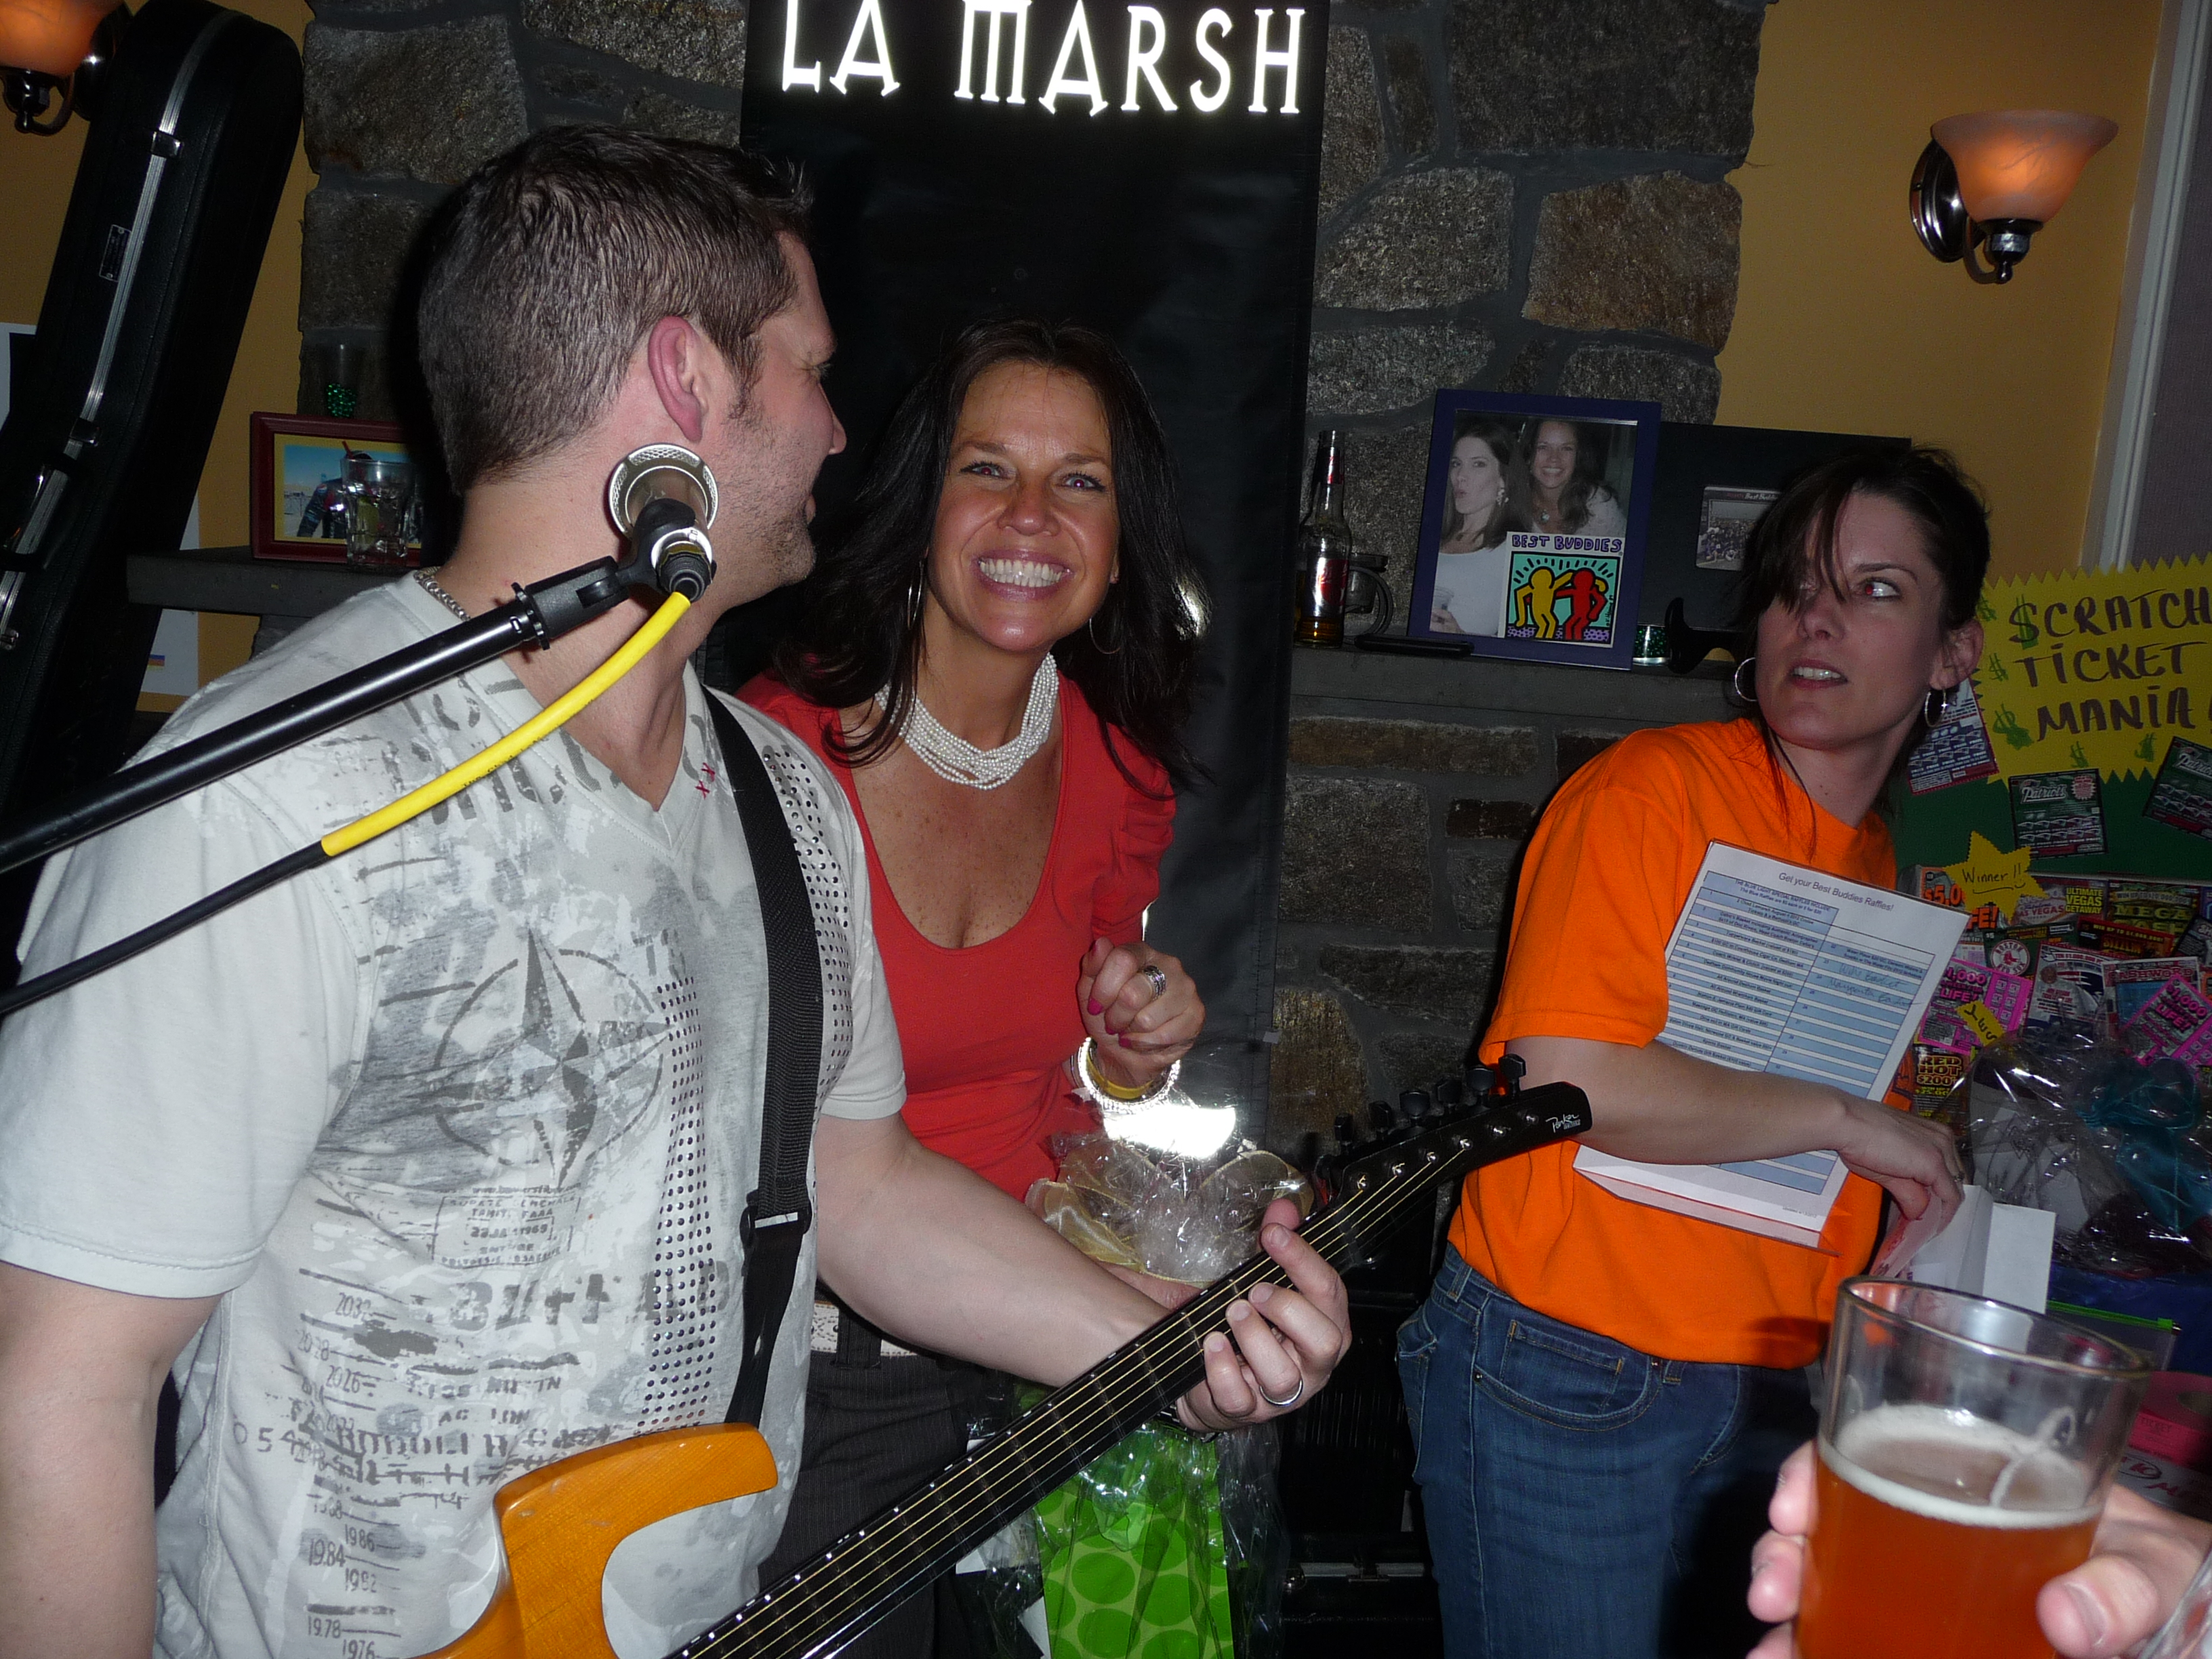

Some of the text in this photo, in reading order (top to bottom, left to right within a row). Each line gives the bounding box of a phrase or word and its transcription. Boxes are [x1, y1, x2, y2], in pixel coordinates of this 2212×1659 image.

[782, 0, 1305, 116] LA MARSH
[1512, 535, 1622, 552] BEST BUDDIES
[2013, 642, 2208, 687] TICKET
[2020, 783, 2068, 804] Patriots
[1778, 872, 1893, 912] Get your Best Buddies Raffles!
[2066, 887, 2104, 896] ULTIMATE
[2066, 895, 2104, 907] VEGAS
[2032, 906, 2065, 916] VEGAS
[2065, 905, 2103, 914] GETAWAY
[2114, 904, 2192, 920] MEGA
[1995, 942, 2024, 954] BOSTON
[1939, 987, 1979, 1005] LIFE!
[1919, 1055, 1962, 1065] RED
[1919, 1065, 1962, 1076] HOT
[1545, 1113, 1580, 1133] Parker
[345, 1523, 375, 1552] 1986
